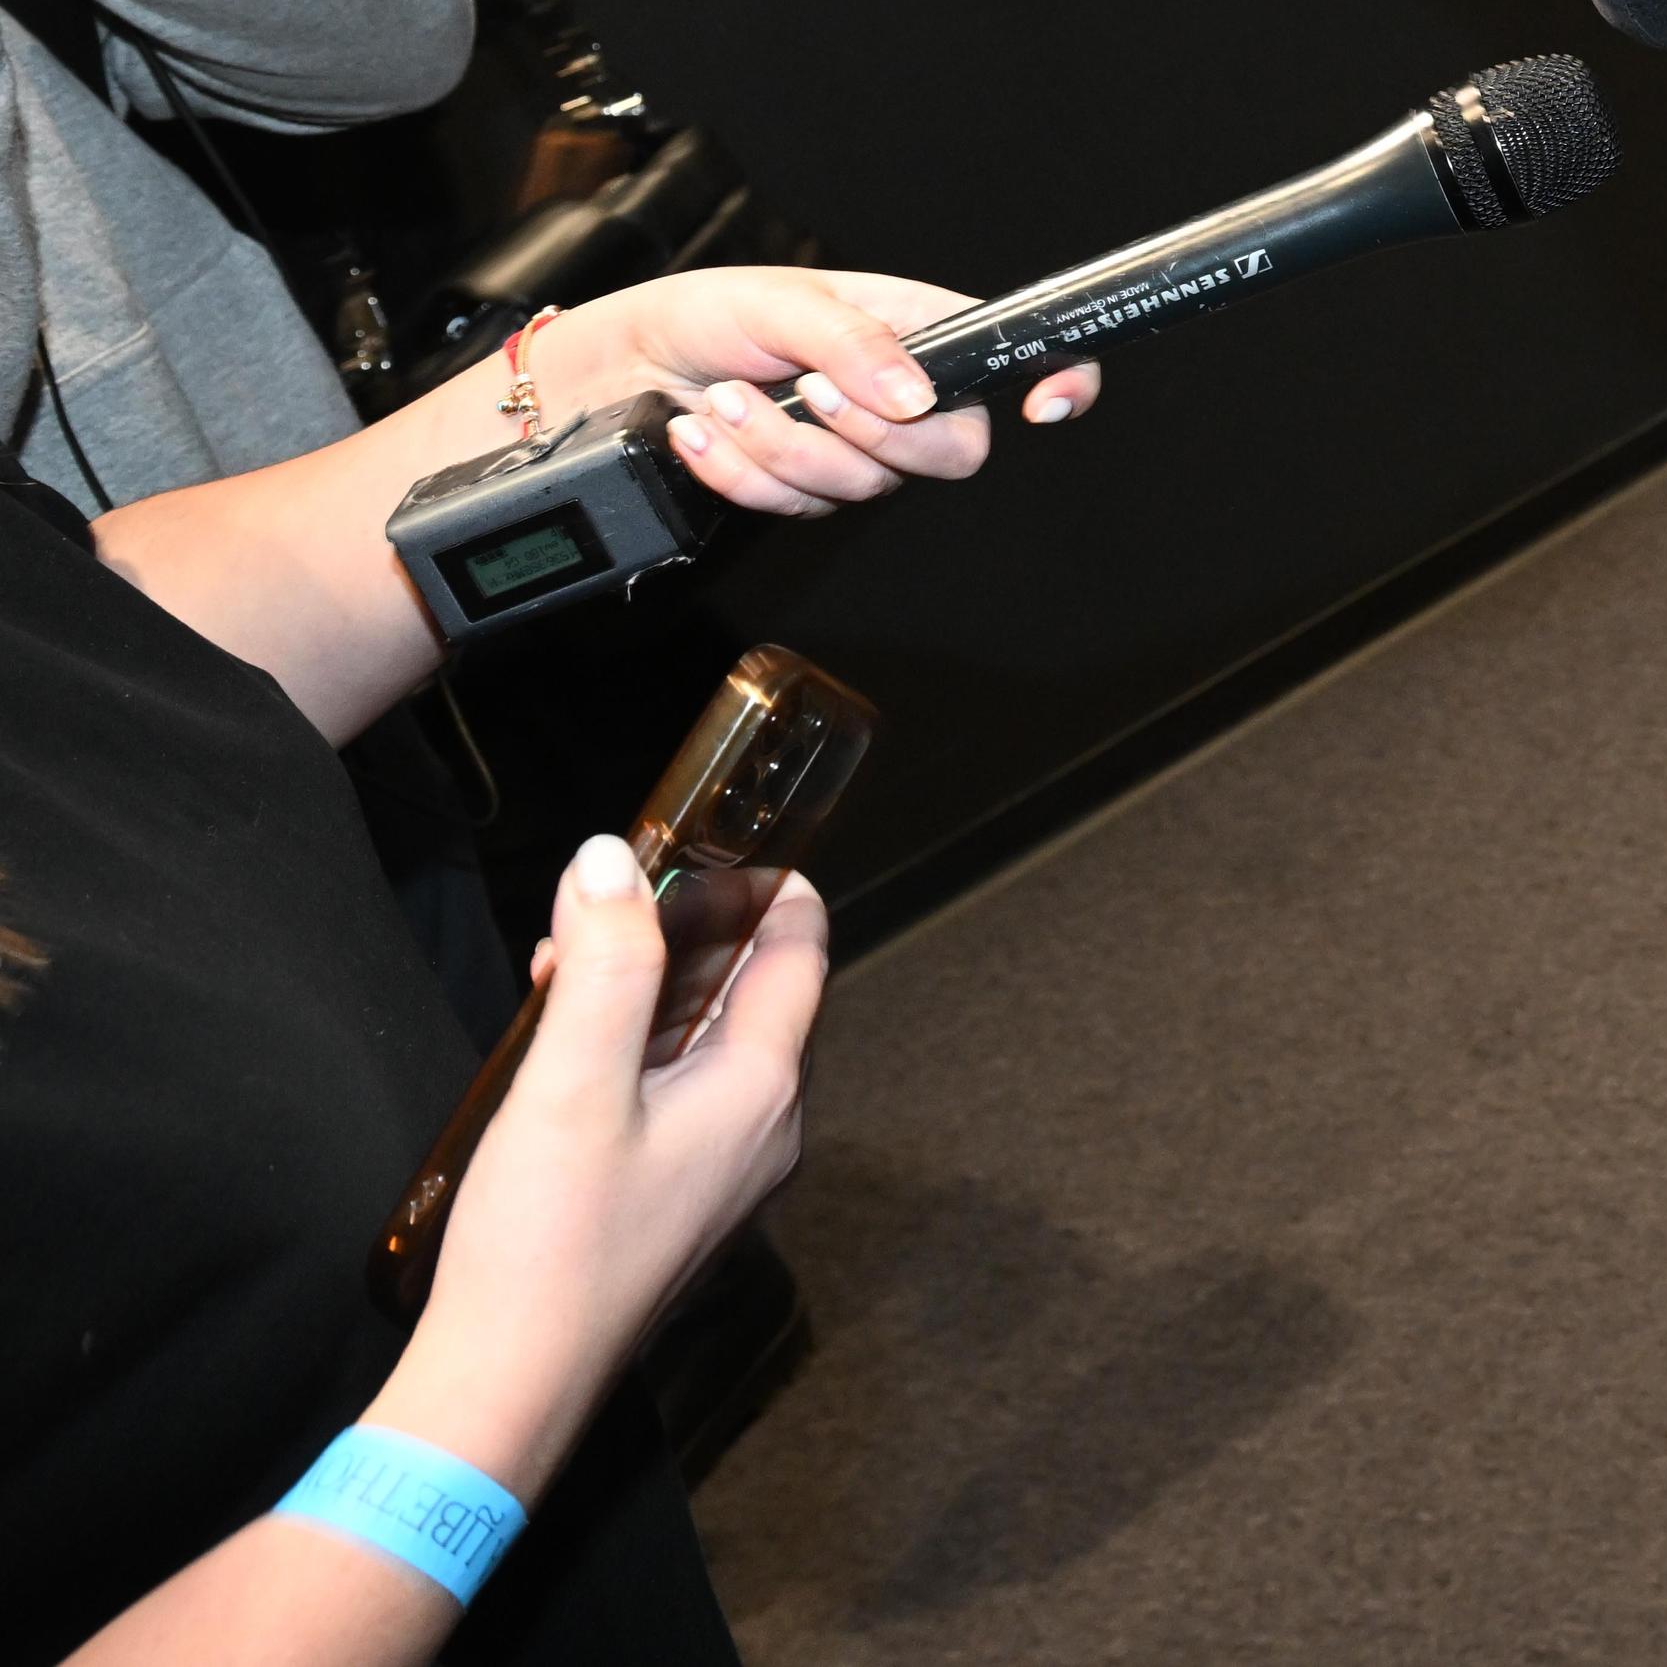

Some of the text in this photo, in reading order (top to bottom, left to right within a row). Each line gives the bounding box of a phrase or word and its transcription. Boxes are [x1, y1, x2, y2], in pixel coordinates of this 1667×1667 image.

[986, 268, 1231, 371] SENNHEISER MD 46
[1056, 282, 1150, 325] MADE IN GERMANY
[300, 1450, 505, 1567] ЦВЕТНО
